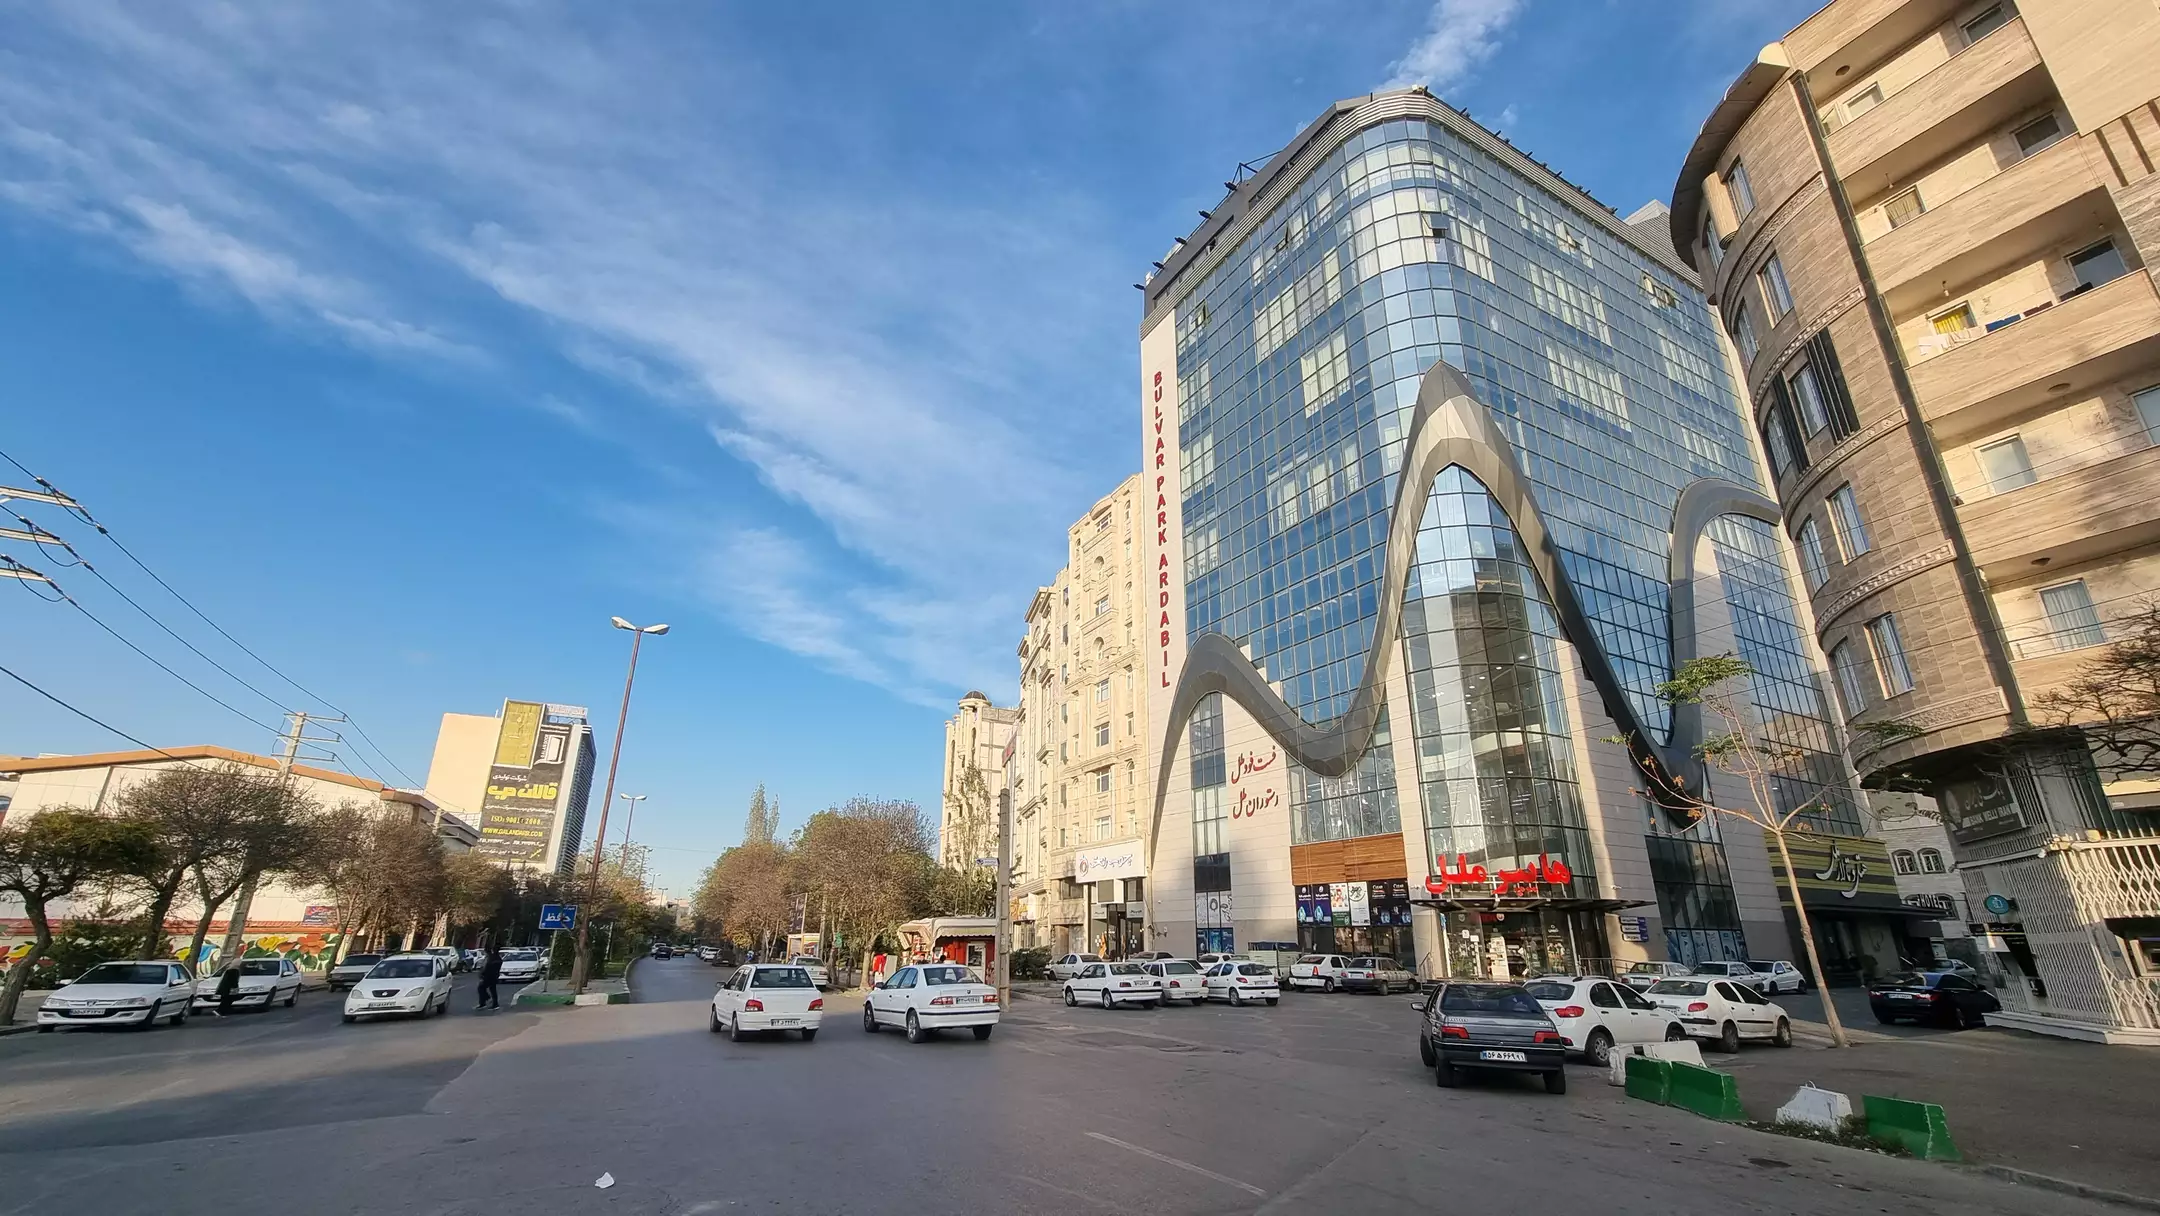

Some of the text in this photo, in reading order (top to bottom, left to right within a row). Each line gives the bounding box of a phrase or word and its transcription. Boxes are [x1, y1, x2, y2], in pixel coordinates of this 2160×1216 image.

[1153, 371, 1171, 688] BULVAR PARK ARDABIL
[1243, 751, 1254, 775] فود
[1253, 745, 1277, 772] فست
[510, 774, 527, 782] شرکت
[1246, 788, 1279, 818] رستوران
[1425, 851, 1572, 897] هایپر ملل
